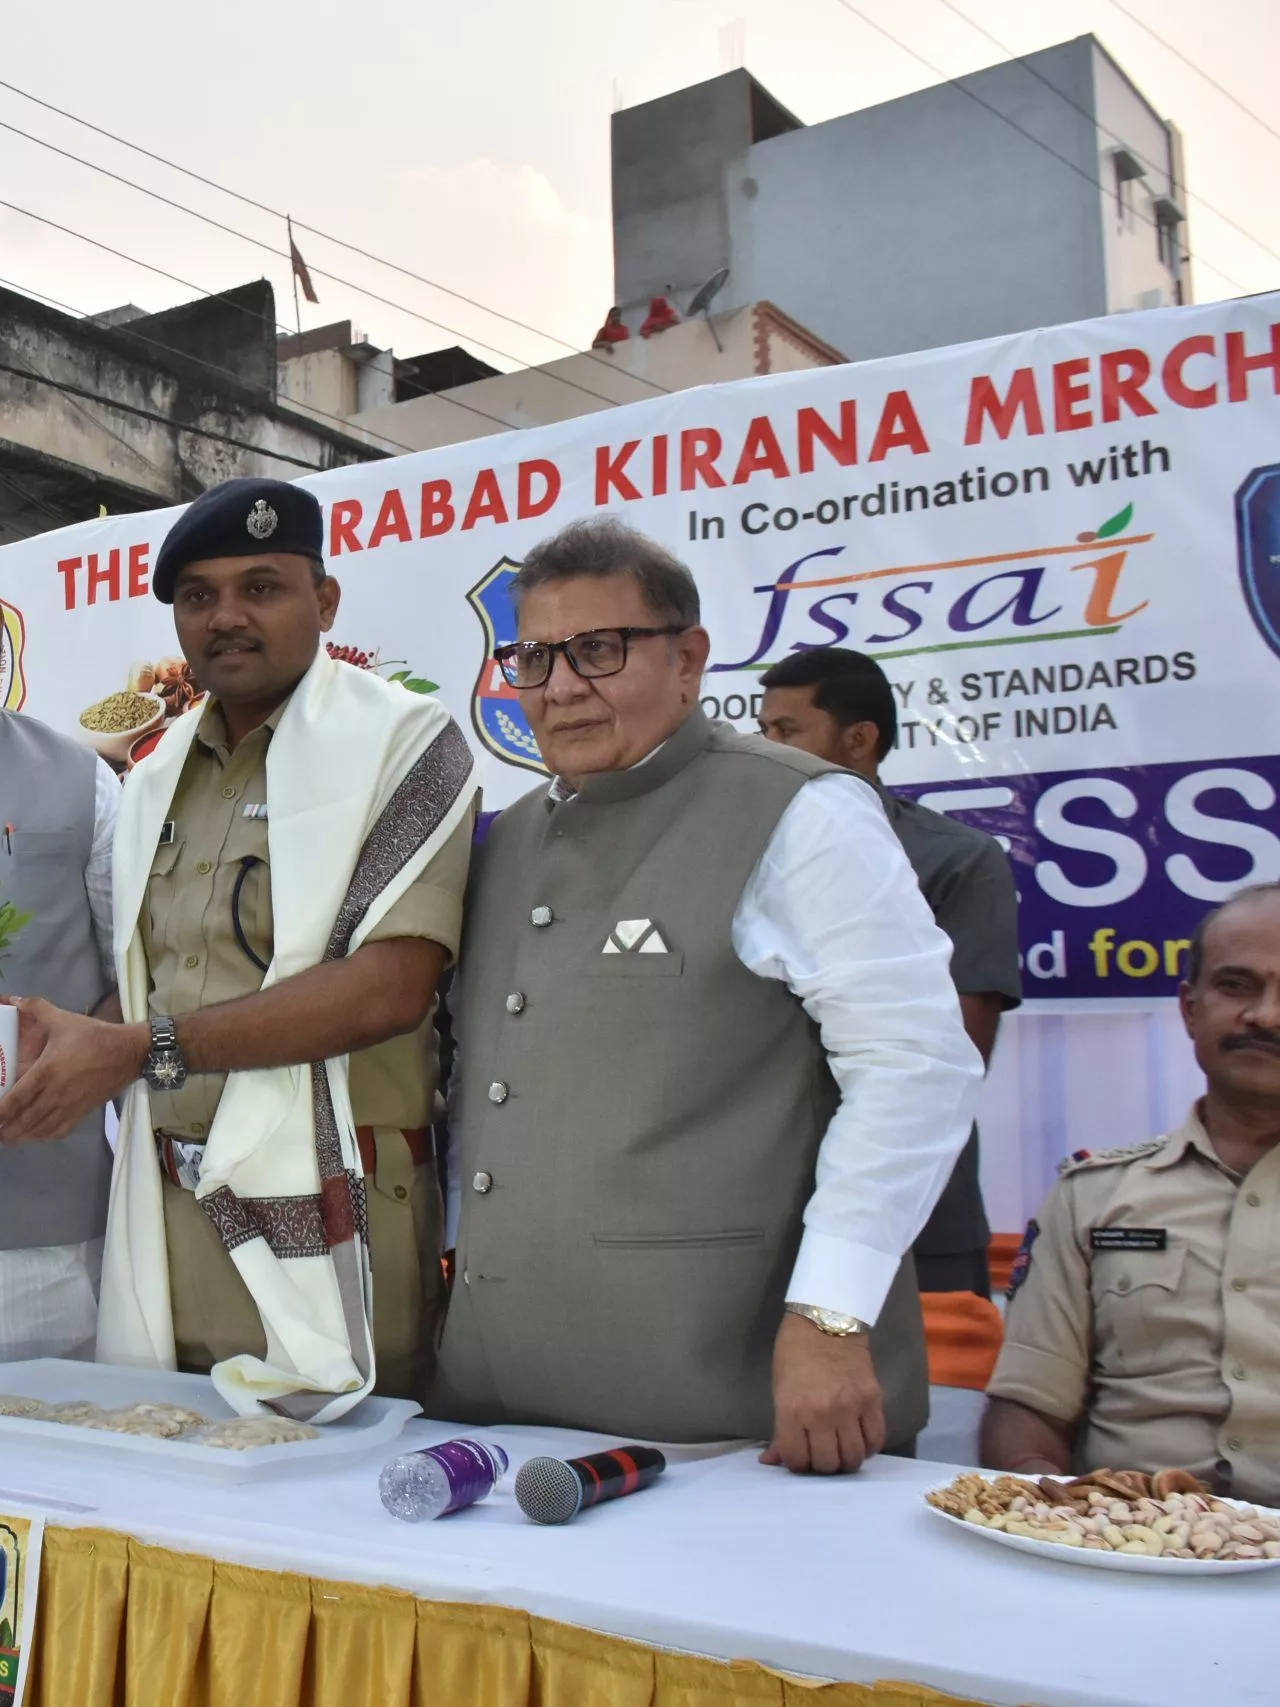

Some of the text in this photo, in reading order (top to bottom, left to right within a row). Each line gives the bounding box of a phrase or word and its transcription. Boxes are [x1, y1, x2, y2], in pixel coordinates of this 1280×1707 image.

[57, 542, 150, 610] THE
[329, 458, 561, 557] RABAD
[594, 390, 930, 505] KIRANA
[689, 440, 1171, 541] In Co-ordination with
[706, 504, 1155, 672] fssai
[927, 677, 950, 706] &
[960, 651, 1197, 702] STANDARDS
[956, 713, 1001, 746] OF
[1016, 703, 1118, 739] INDIA
[1088, 927, 1192, 979] for
